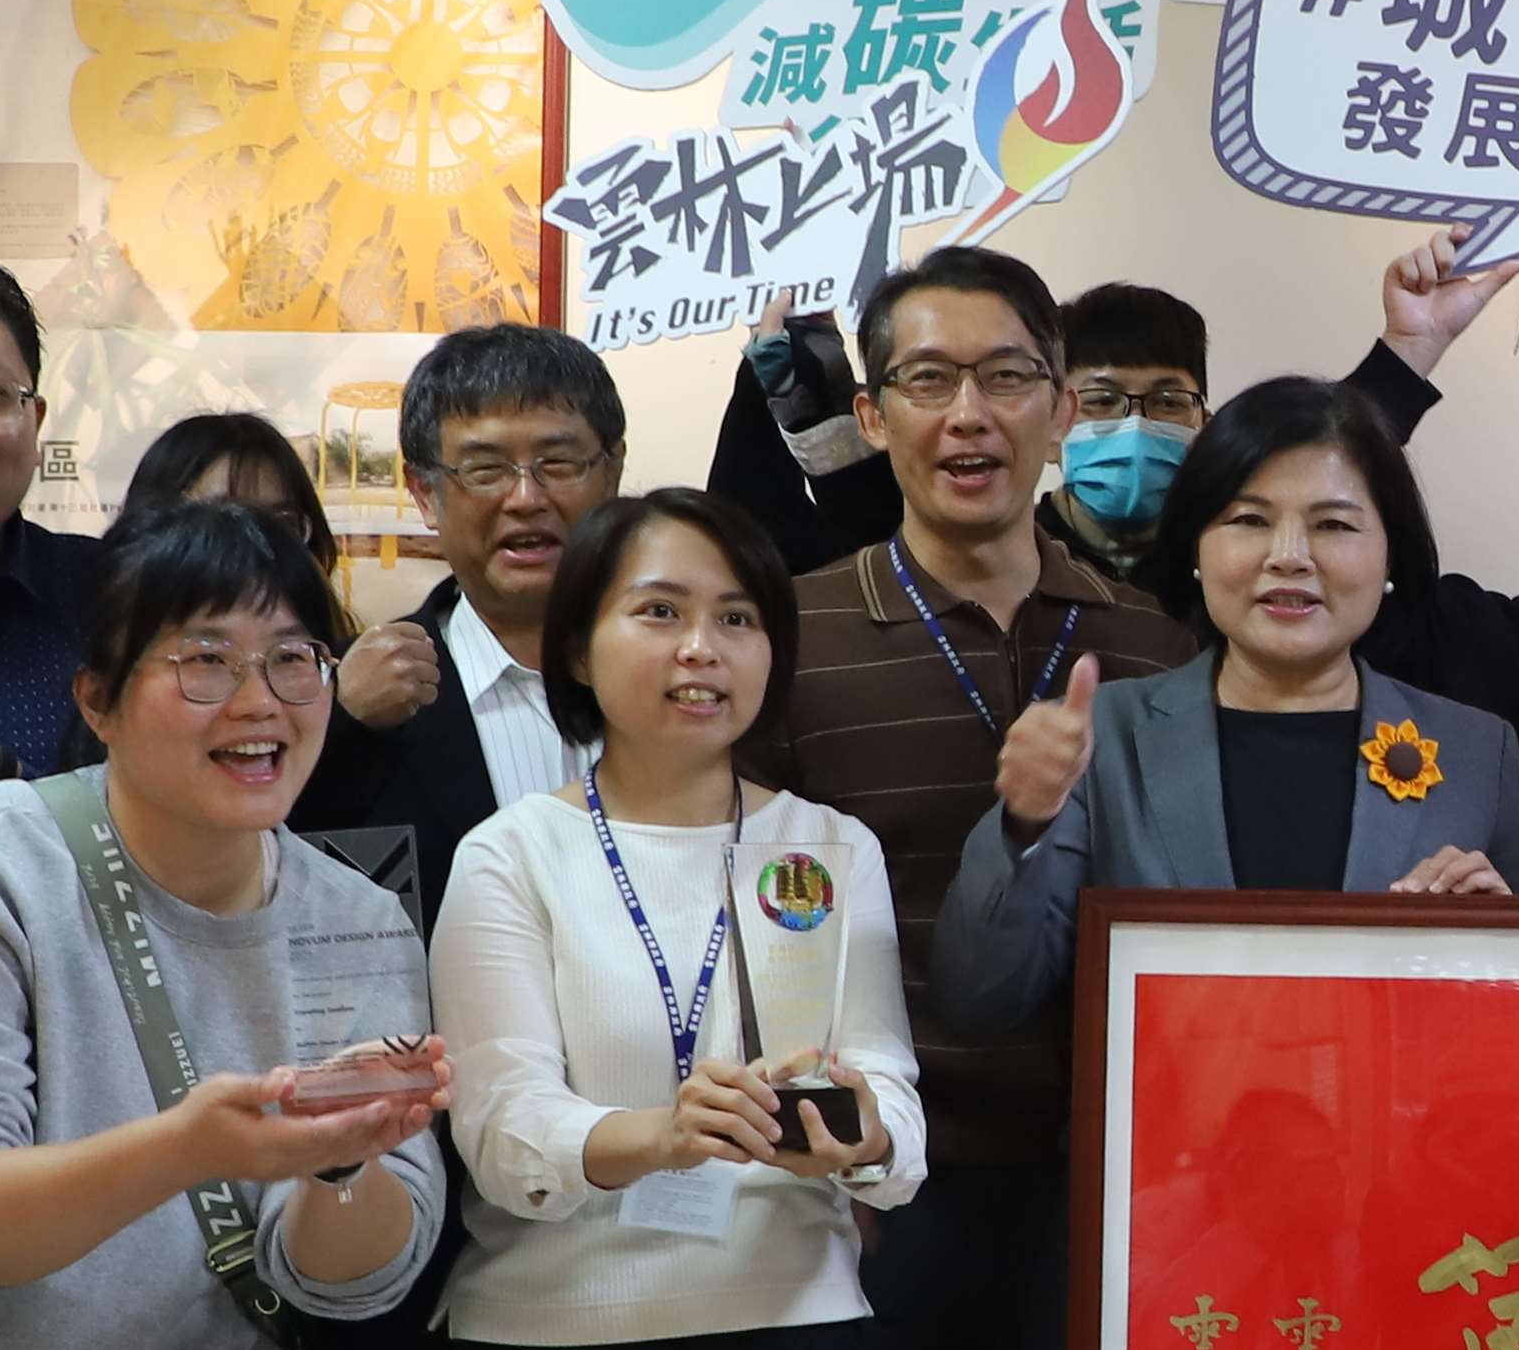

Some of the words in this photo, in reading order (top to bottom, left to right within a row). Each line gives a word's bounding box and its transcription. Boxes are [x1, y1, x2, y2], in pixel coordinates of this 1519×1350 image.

[553, 80, 968, 318] 雲林上場
[591, 306, 656, 343] It's
[668, 295, 736, 330] Our
